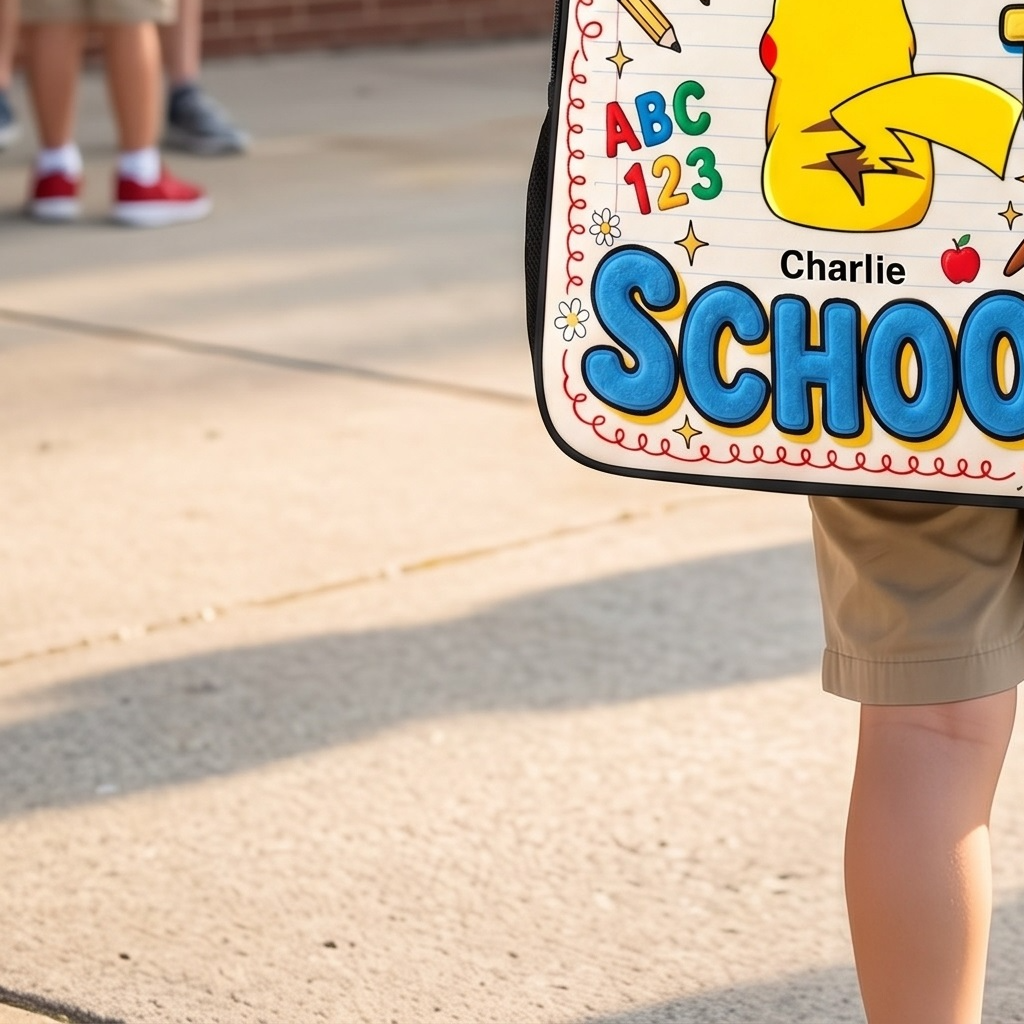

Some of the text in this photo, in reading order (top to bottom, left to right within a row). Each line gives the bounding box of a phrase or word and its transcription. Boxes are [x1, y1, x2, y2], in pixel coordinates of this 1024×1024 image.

[605, 80, 712, 158] ABC
[623, 146, 724, 216] 123
[779, 249, 907, 286] Charlie
